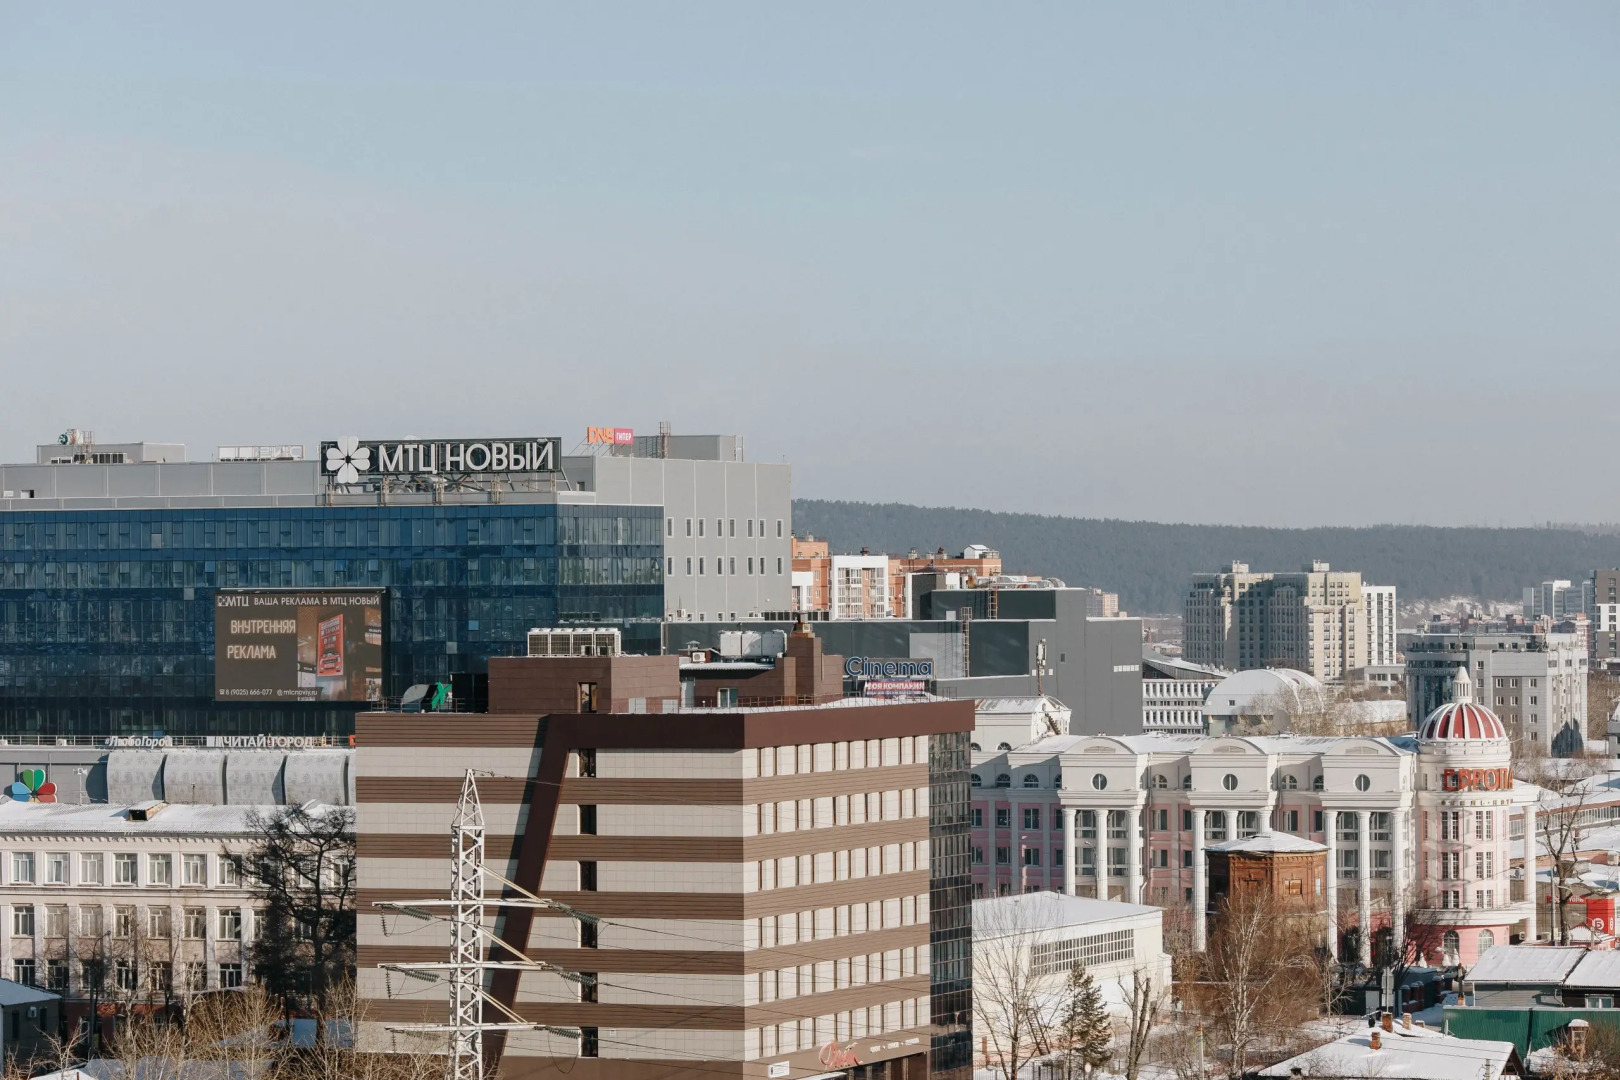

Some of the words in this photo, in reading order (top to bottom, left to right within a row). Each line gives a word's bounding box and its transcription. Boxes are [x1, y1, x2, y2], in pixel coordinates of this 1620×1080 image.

[587, 427, 614, 443] DNS
[378, 443, 438, 474] МТЦ
[445, 438, 554, 471] НОВЫЙ
[226, 596, 249, 607] МТЦ
[254, 597, 279, 606] ВАША
[281, 597, 320, 606] РЕКЛАМА
[322, 597, 328, 605] В
[330, 597, 347, 607] МТЦ
[349, 595, 380, 606] НОВЫЙ
[230, 619, 297, 635] ВНУТРЕННЯЯ
[227, 645, 277, 660] РЕКЛАМА
[845, 656, 933, 677] Cinema
[1443, 768, 1514, 792] ЕВРОПА
